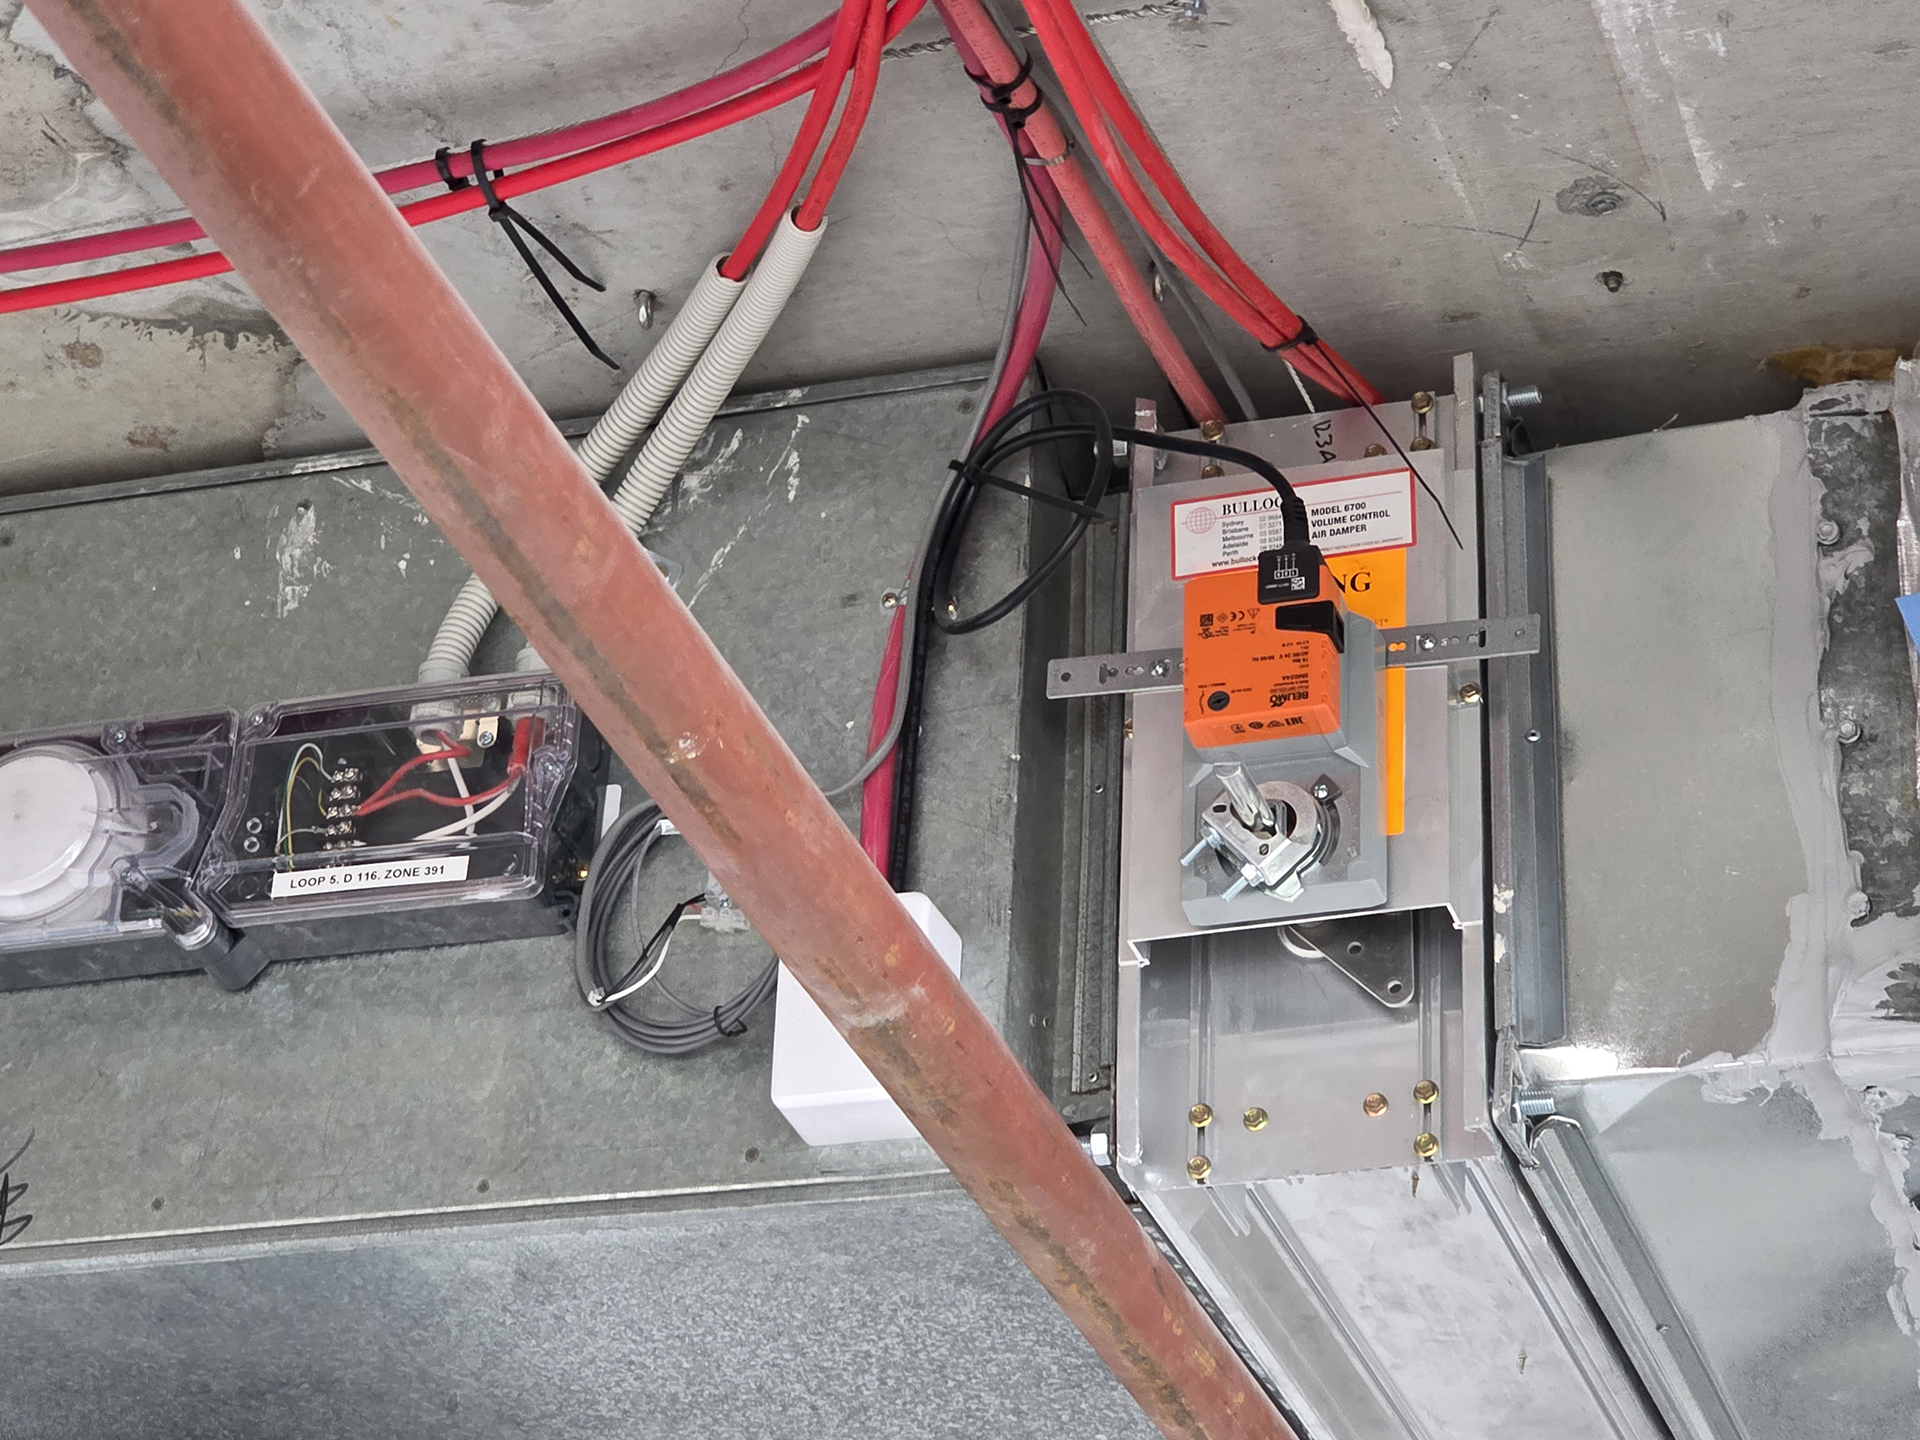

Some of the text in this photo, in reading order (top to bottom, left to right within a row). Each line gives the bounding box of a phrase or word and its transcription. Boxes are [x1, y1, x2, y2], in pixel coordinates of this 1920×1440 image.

[1221, 496, 1282, 517] BULLOC
[1310, 501, 1367, 517] MODEL 6700
[1221, 520, 1245, 528] Sydney
[1310, 508, 1391, 528] VOLUME CONTROL
[1221, 526, 1249, 535] Brisbane
[1311, 523, 1368, 540] AIR DAMPER
[1222, 533, 1254, 542] Melbourne
[1222, 541, 1249, 550] Adelaide
[1222, 549, 1239, 557] Perth
[1211, 556, 1257, 569] www.bullock
[1269, 691, 1309, 705] BELIMO
[290, 875, 326, 889] LOOP
[343, 873, 353, 883] D
[384, 867, 421, 880] ZONE
[424, 865, 446, 876] 391
